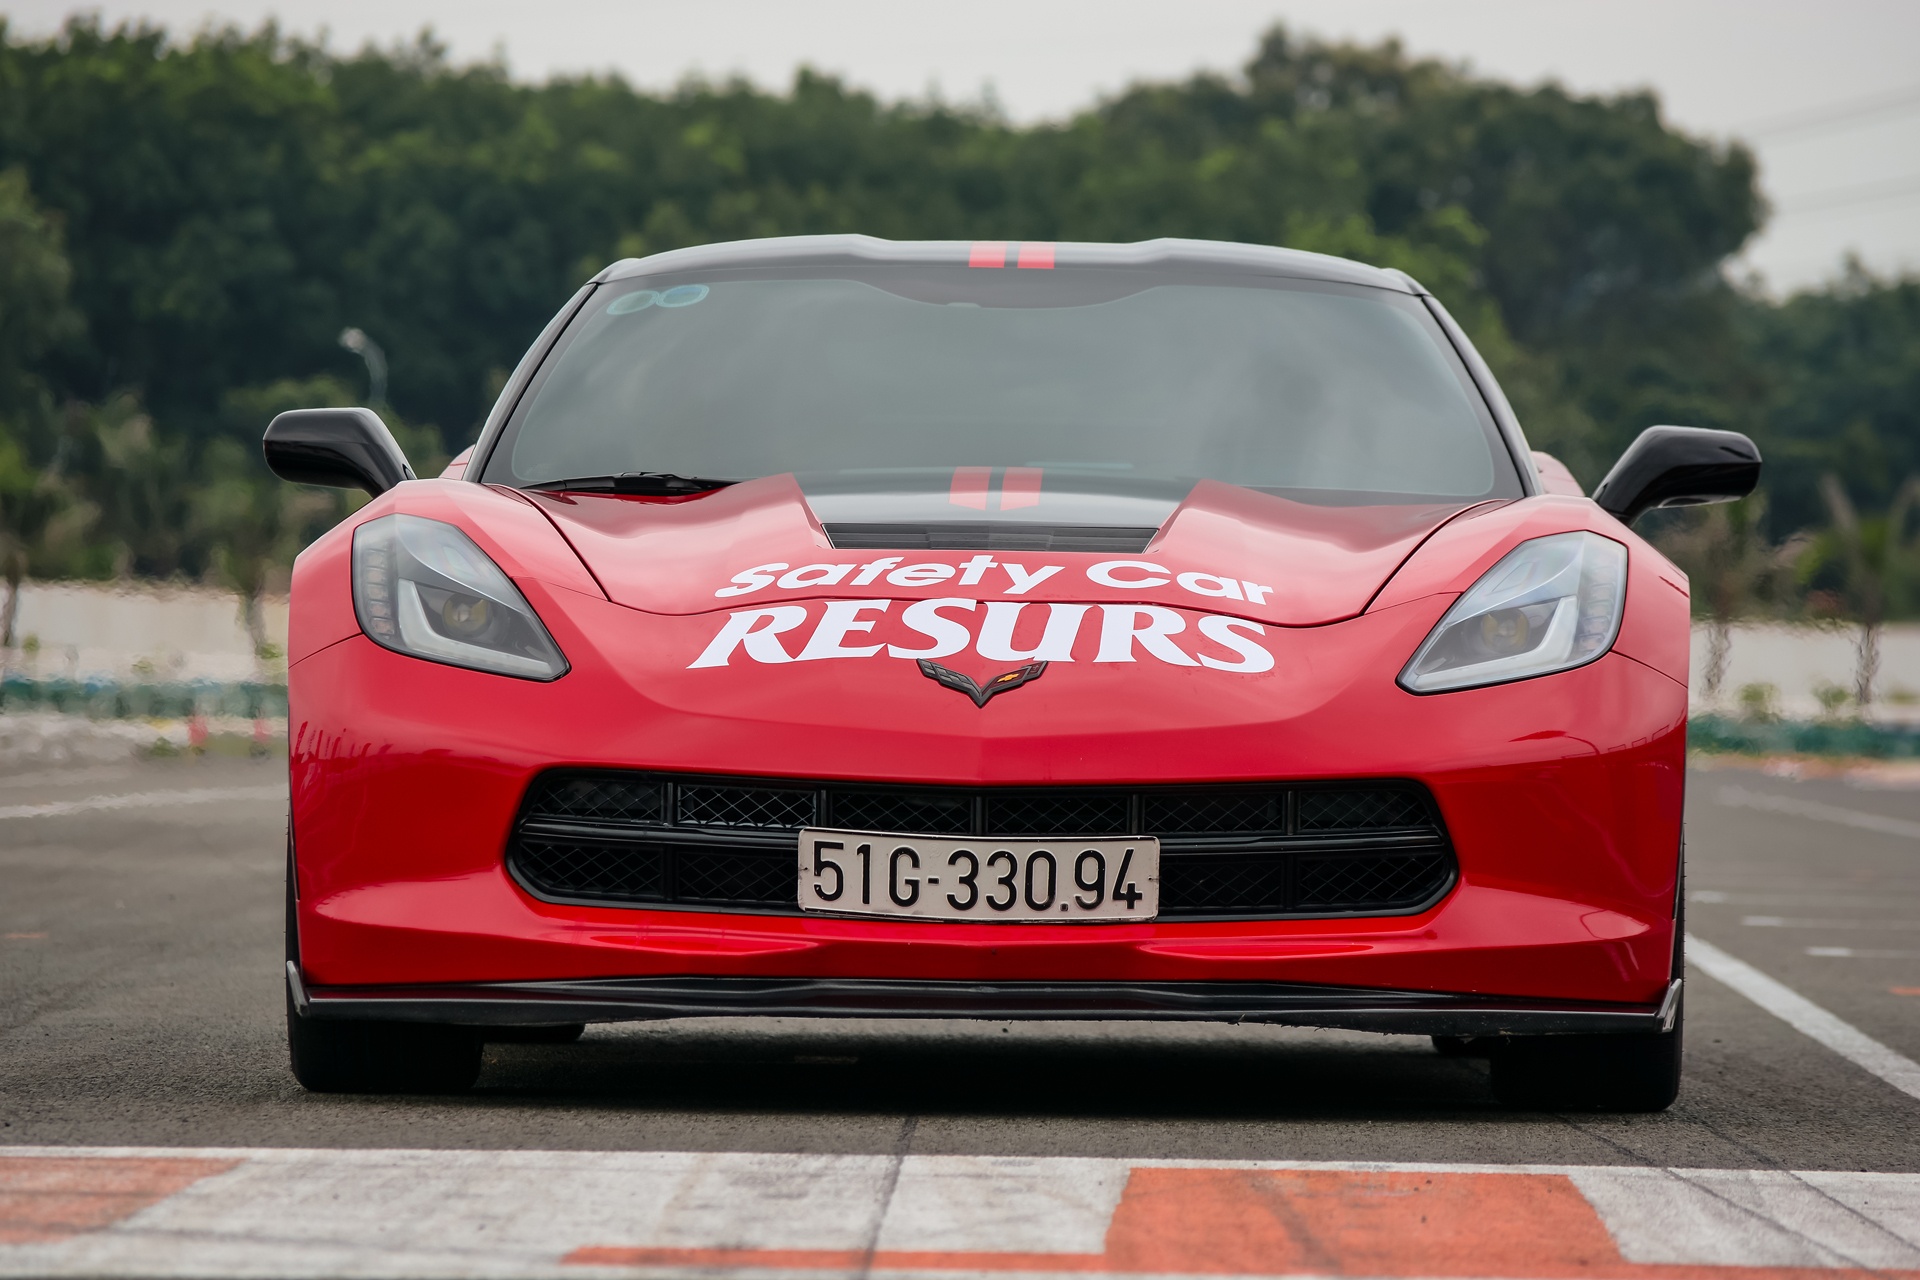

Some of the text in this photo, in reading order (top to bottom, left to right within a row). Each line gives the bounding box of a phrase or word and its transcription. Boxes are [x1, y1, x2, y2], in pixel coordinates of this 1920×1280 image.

[1087, 561, 1274, 605] Car
[687, 598, 1274, 673] RESURS
[813, 841, 1143, 911] 51G-330.94
